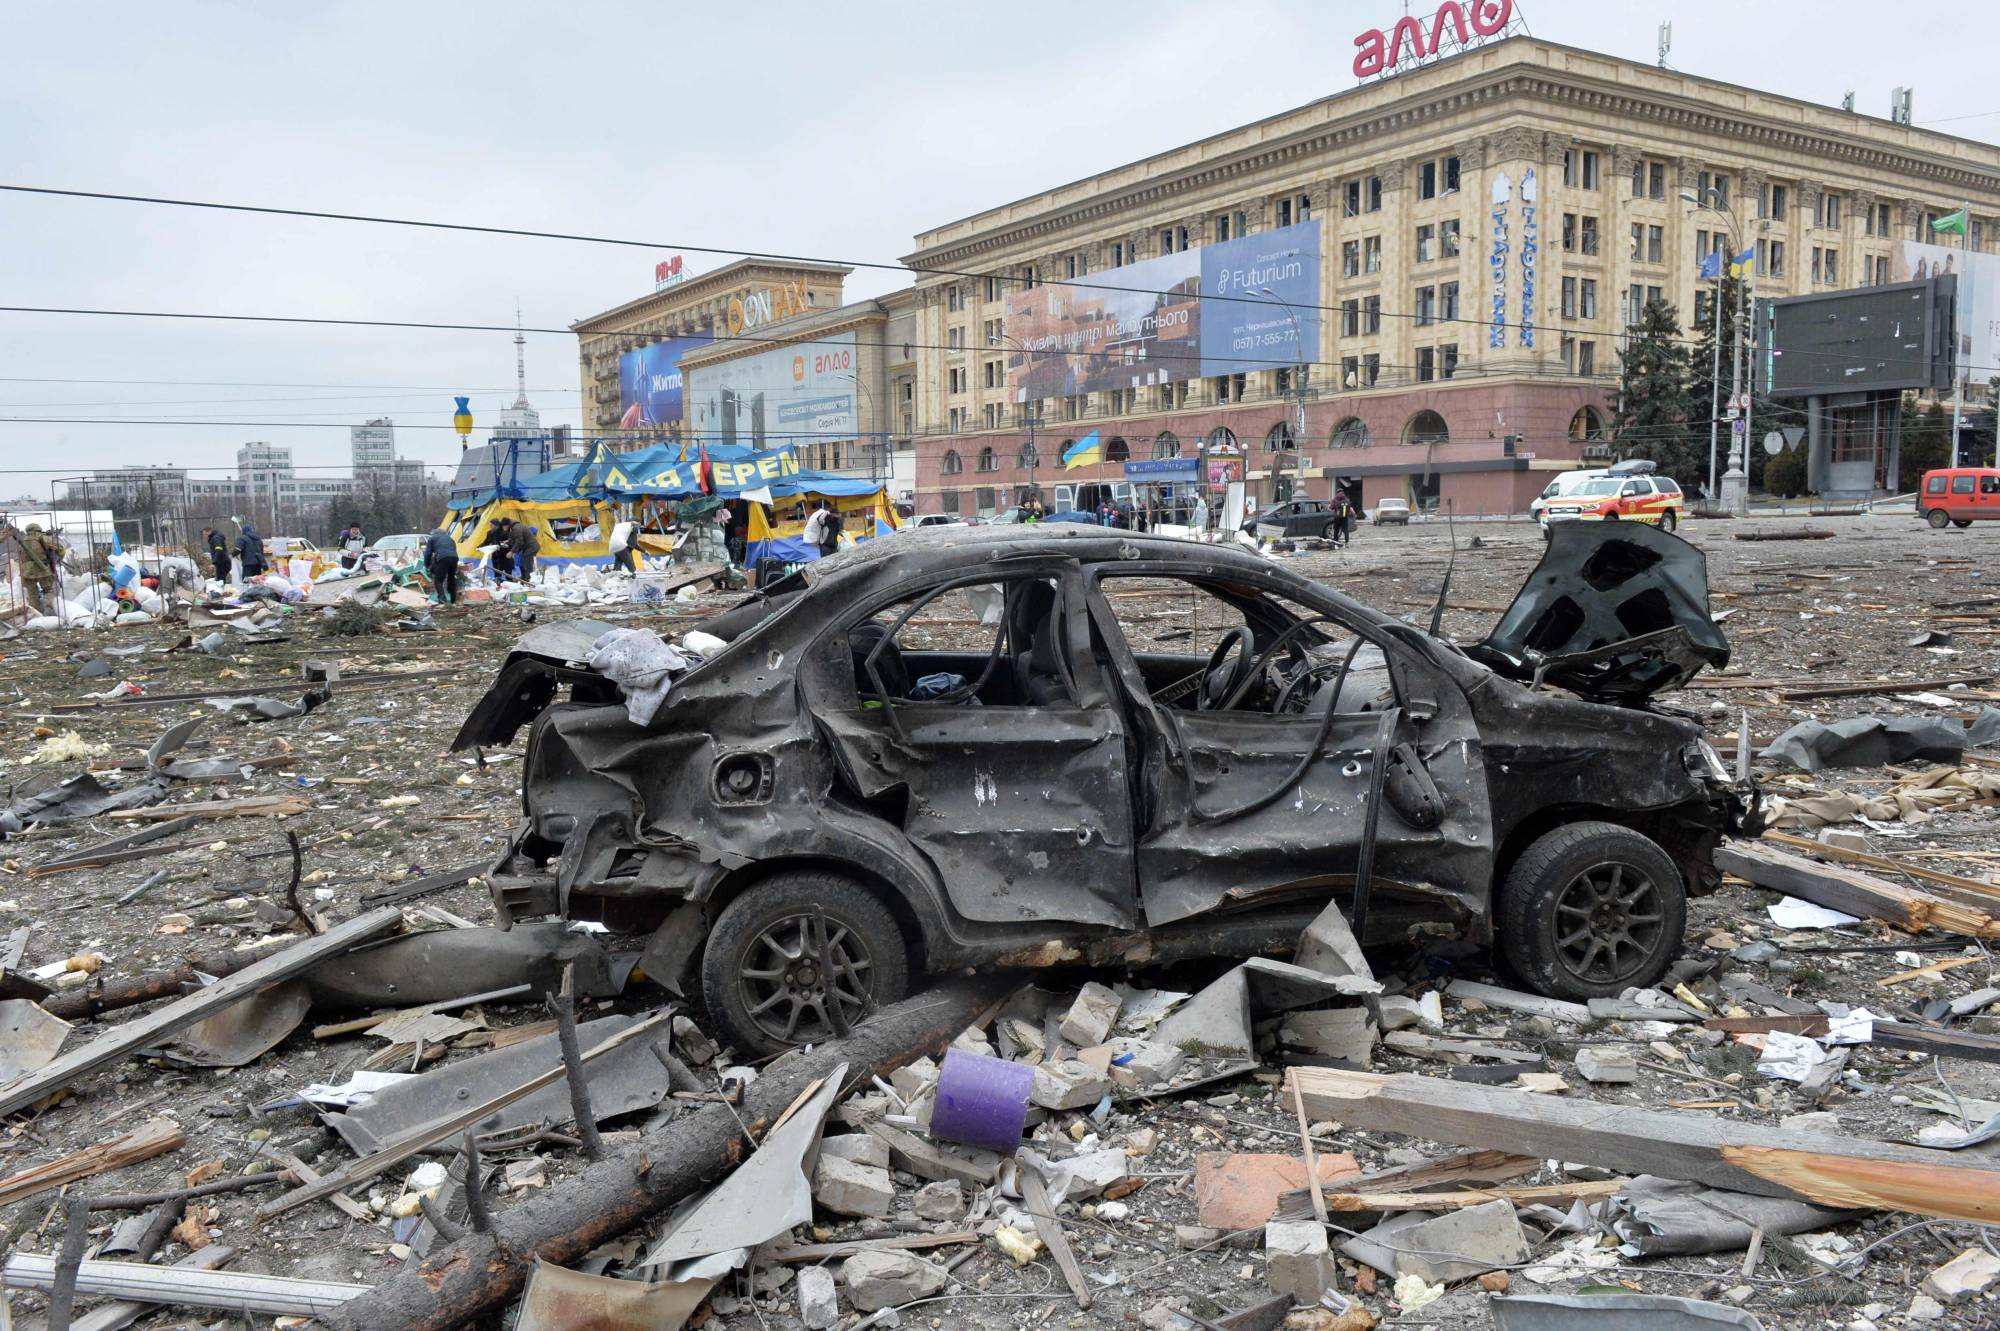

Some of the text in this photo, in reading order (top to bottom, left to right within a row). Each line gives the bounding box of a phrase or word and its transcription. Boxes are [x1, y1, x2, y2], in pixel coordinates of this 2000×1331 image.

[1233, 260, 1301, 289] Futurium
[1106, 309, 1189, 338] майбутнього
[1233, 336, 1254, 352] (057)
[816, 350, 850, 374] алло
[651, 373, 684, 393] Житло
